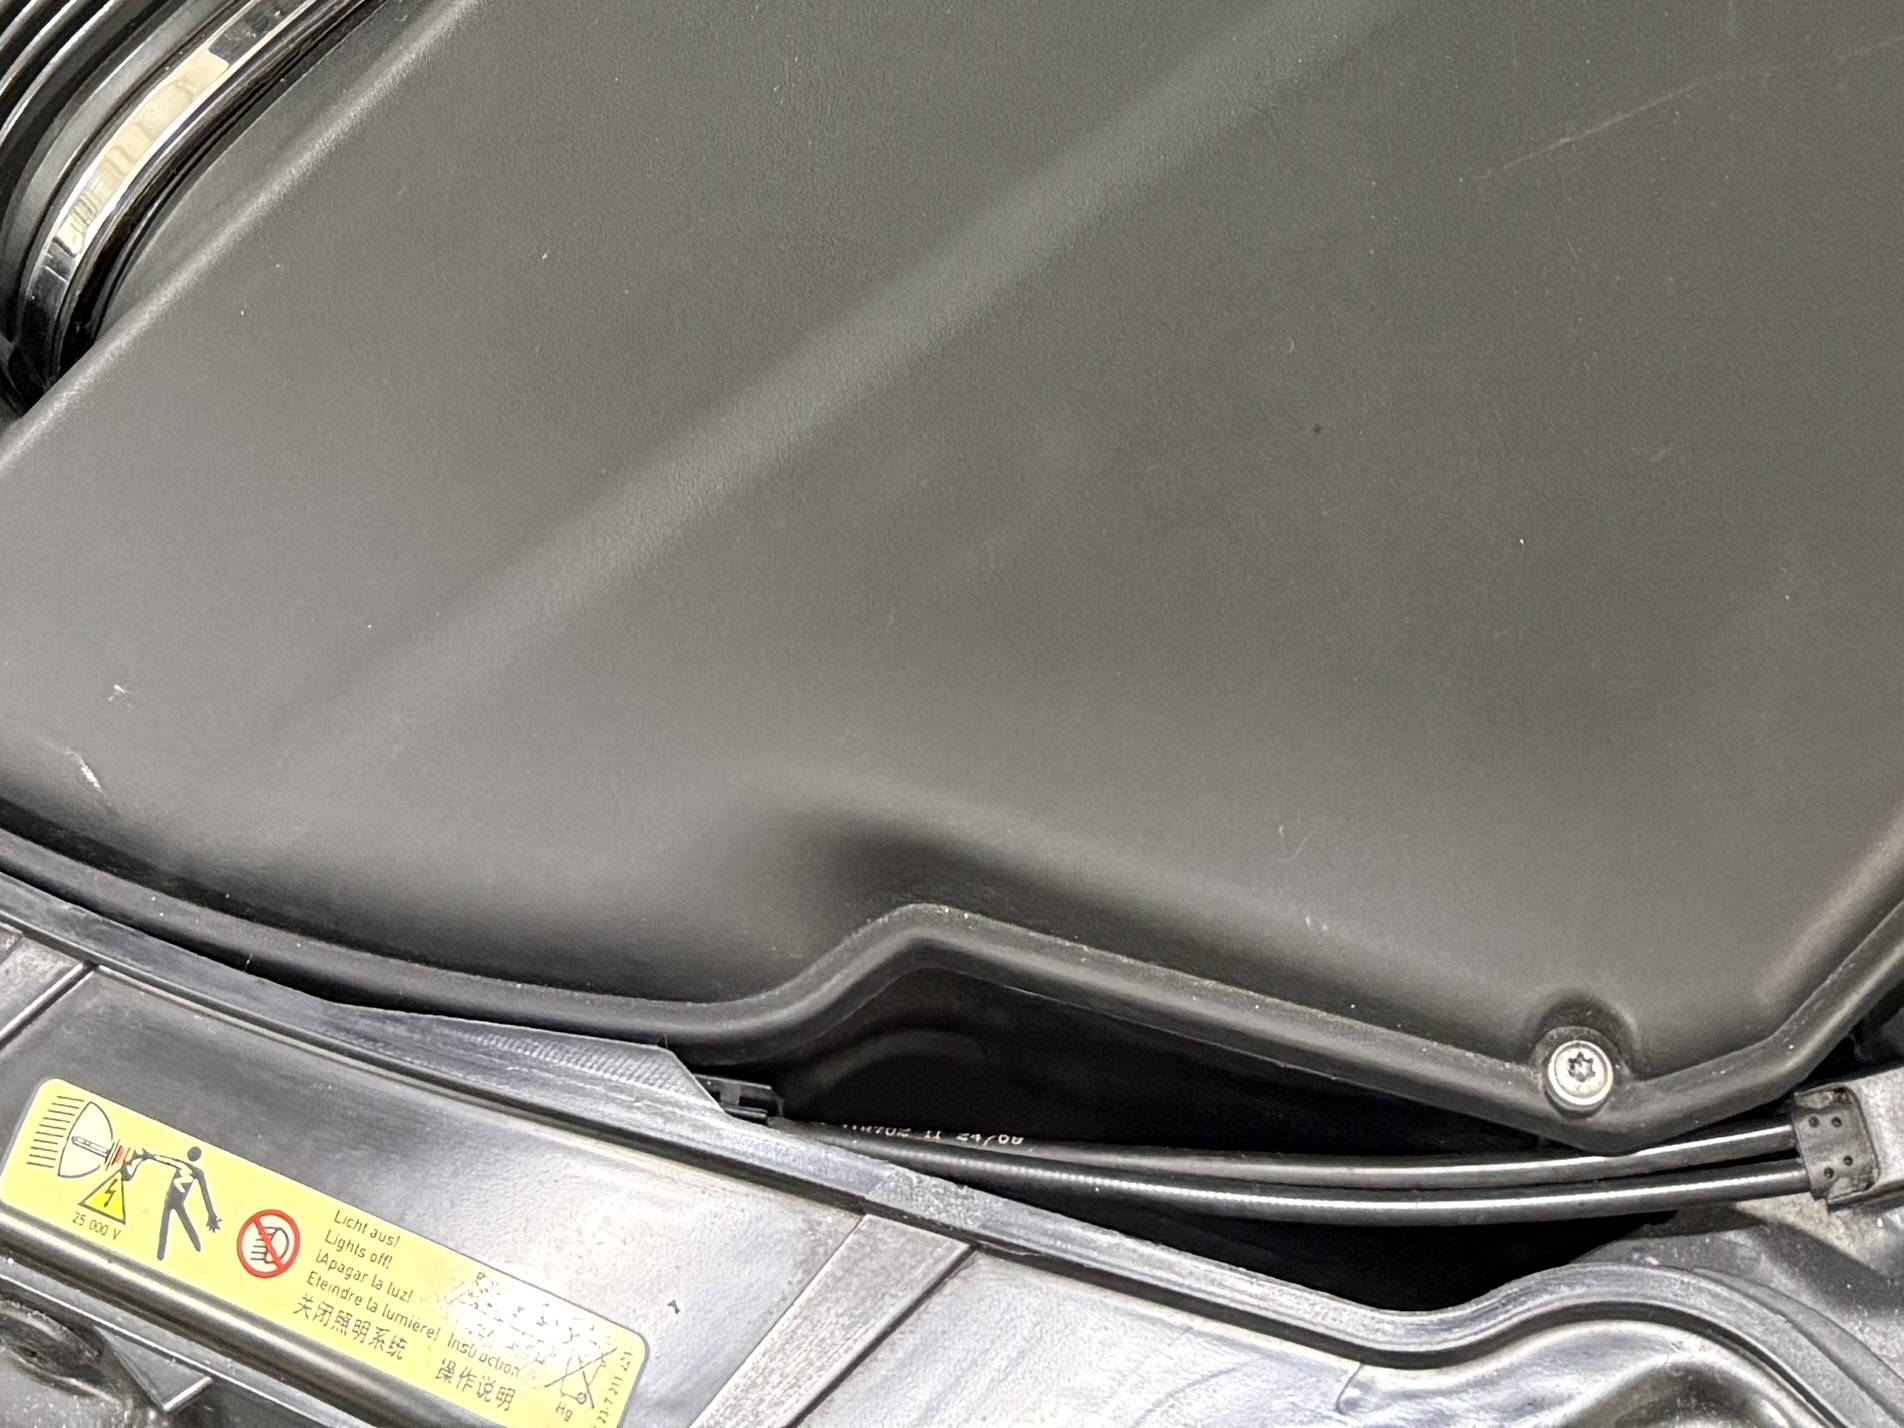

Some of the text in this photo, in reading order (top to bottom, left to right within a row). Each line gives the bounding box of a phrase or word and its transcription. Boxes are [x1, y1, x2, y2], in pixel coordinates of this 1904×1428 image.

[72, 1211, 121, 1240] 25 000 V
[333, 1209, 401, 1248] Licht aus!
[324, 1229, 393, 1270] Lights off!
[315, 1249, 414, 1303] ¡Apagar la luz!
[365, 1297, 379, 1313] la
[293, 1293, 409, 1360] 关闭照明系统
[435, 1357, 516, 1412] 操作说明
[555, 1401, 573, 1422] Hg
